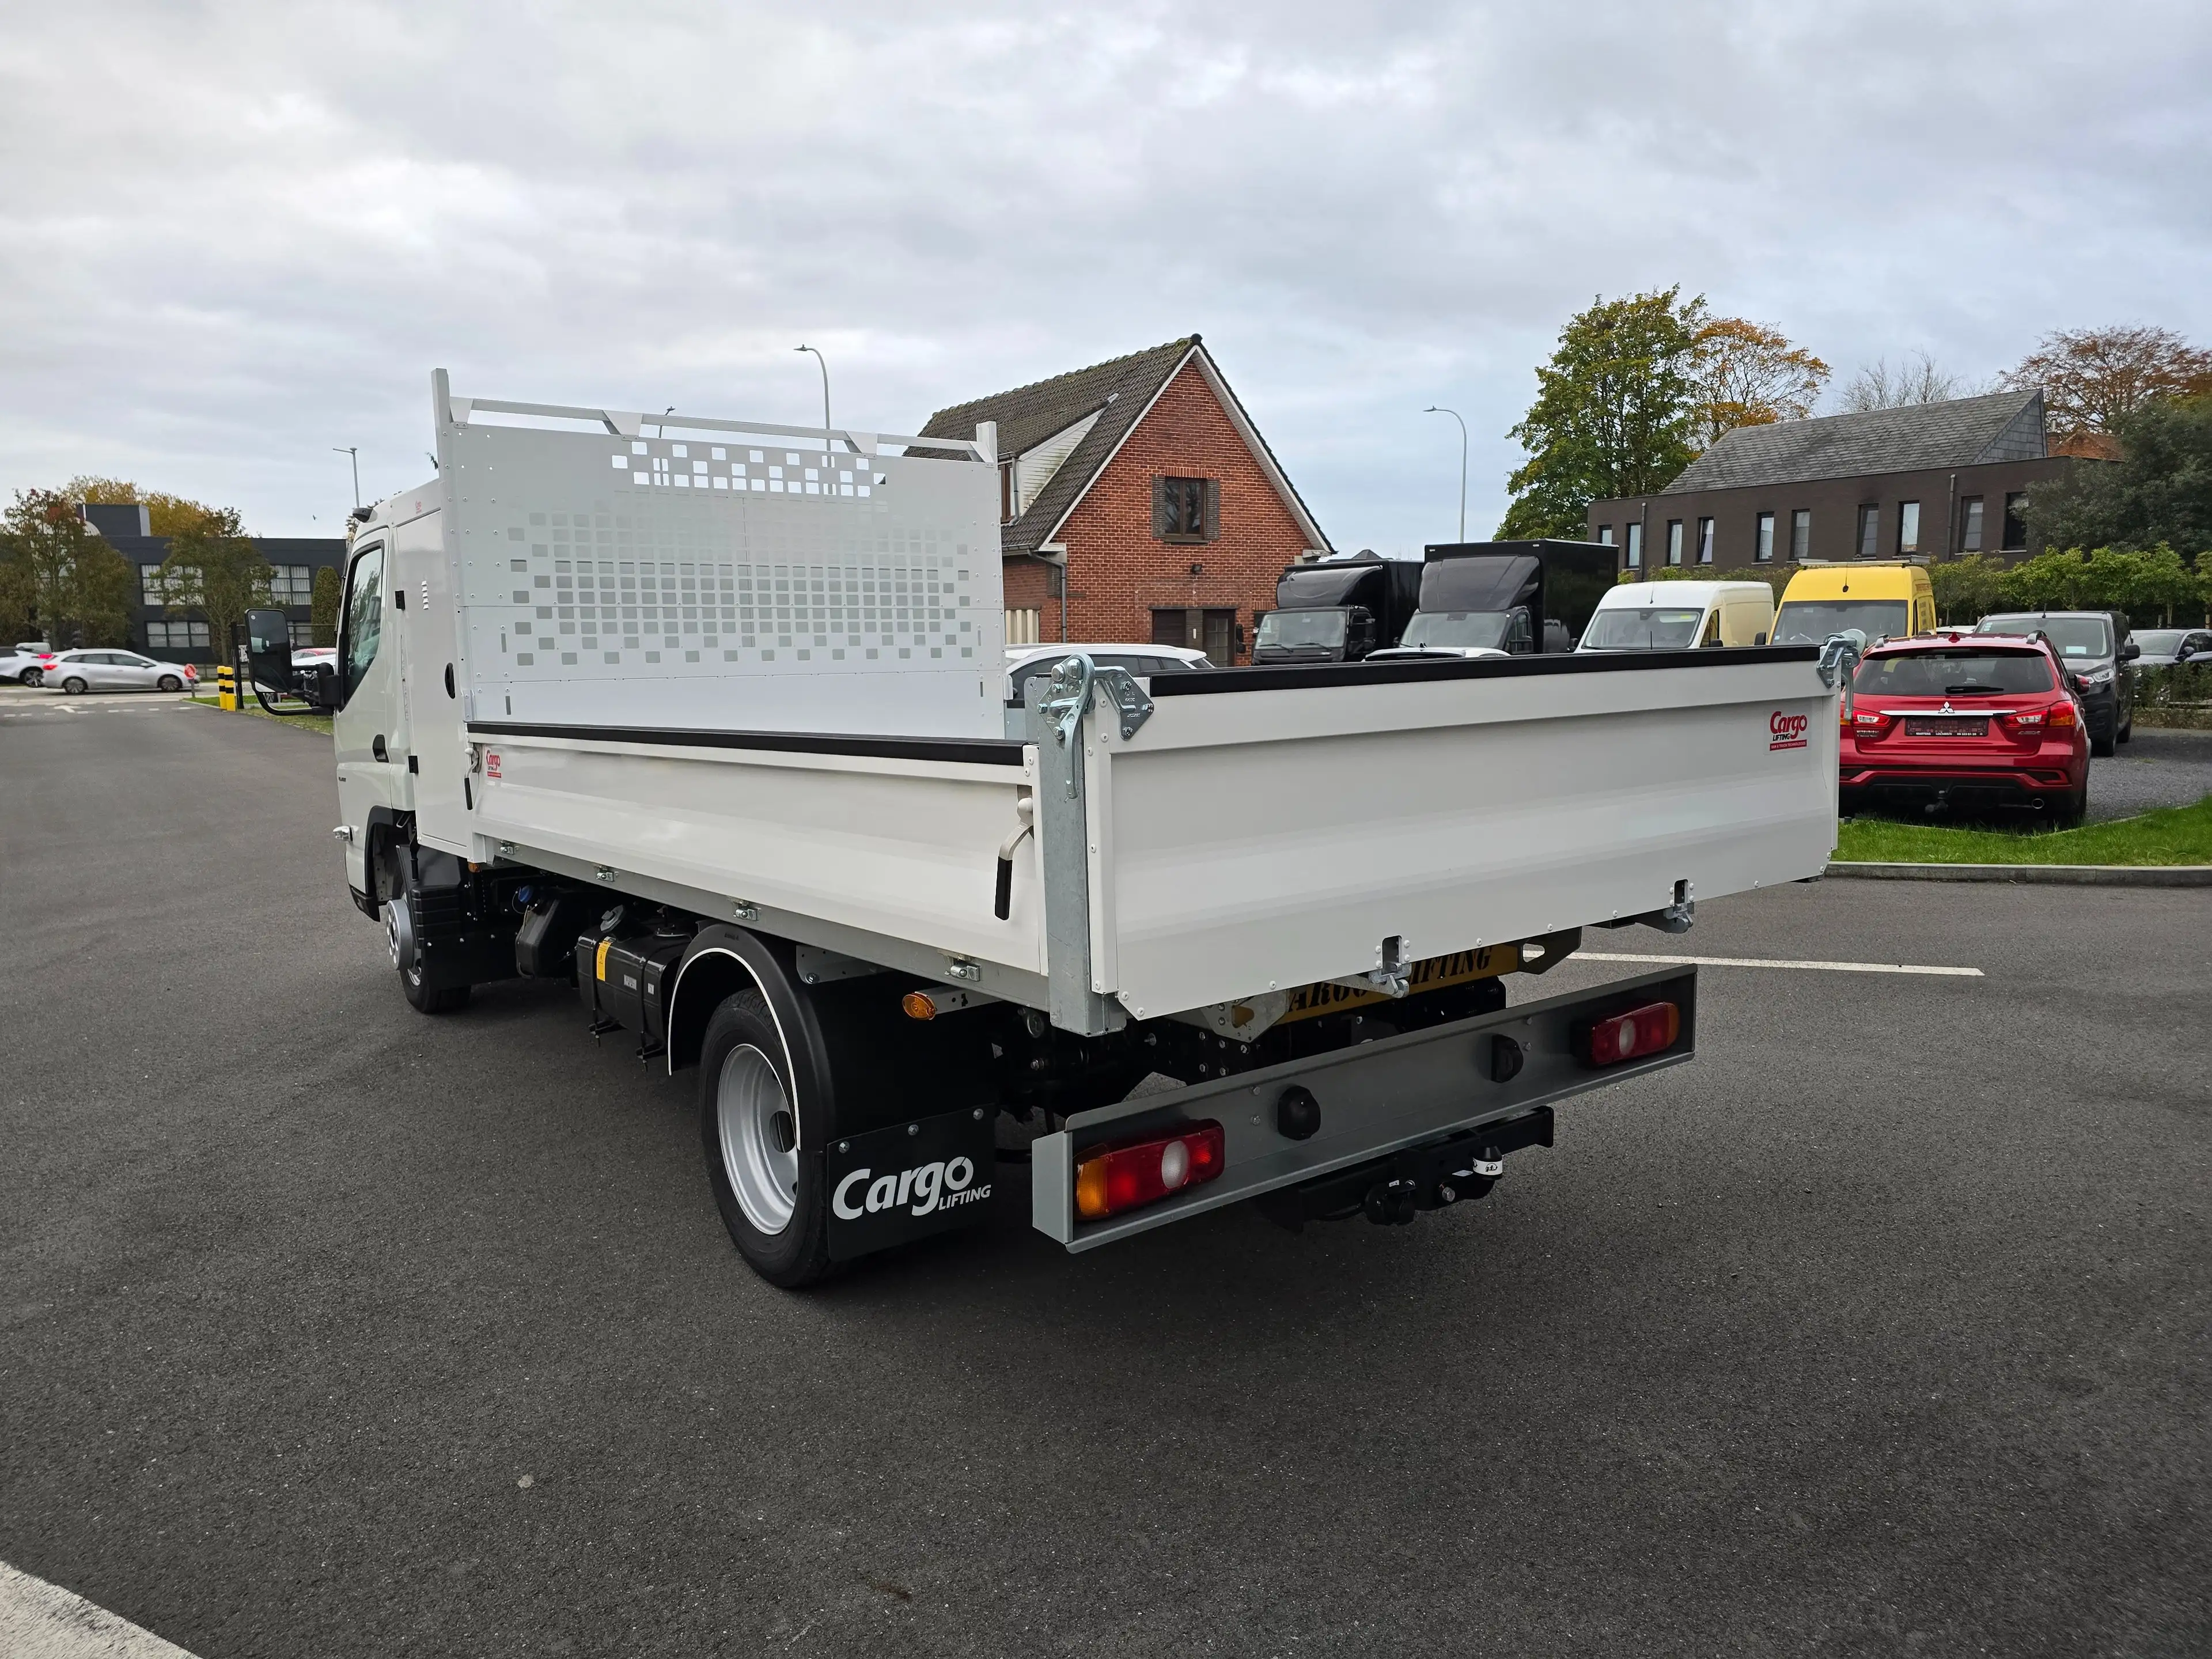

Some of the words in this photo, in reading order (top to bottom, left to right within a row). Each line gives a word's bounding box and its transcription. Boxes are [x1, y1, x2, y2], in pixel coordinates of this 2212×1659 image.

[1770, 711, 1807, 739] Cargo
[1772, 733, 1790, 741] LIFTING
[486, 749, 501, 771] Cargo
[1409, 946, 1493, 985] IFTING
[832, 1156, 974, 1220] Cargo
[938, 1184, 991, 1211] LIFTING
